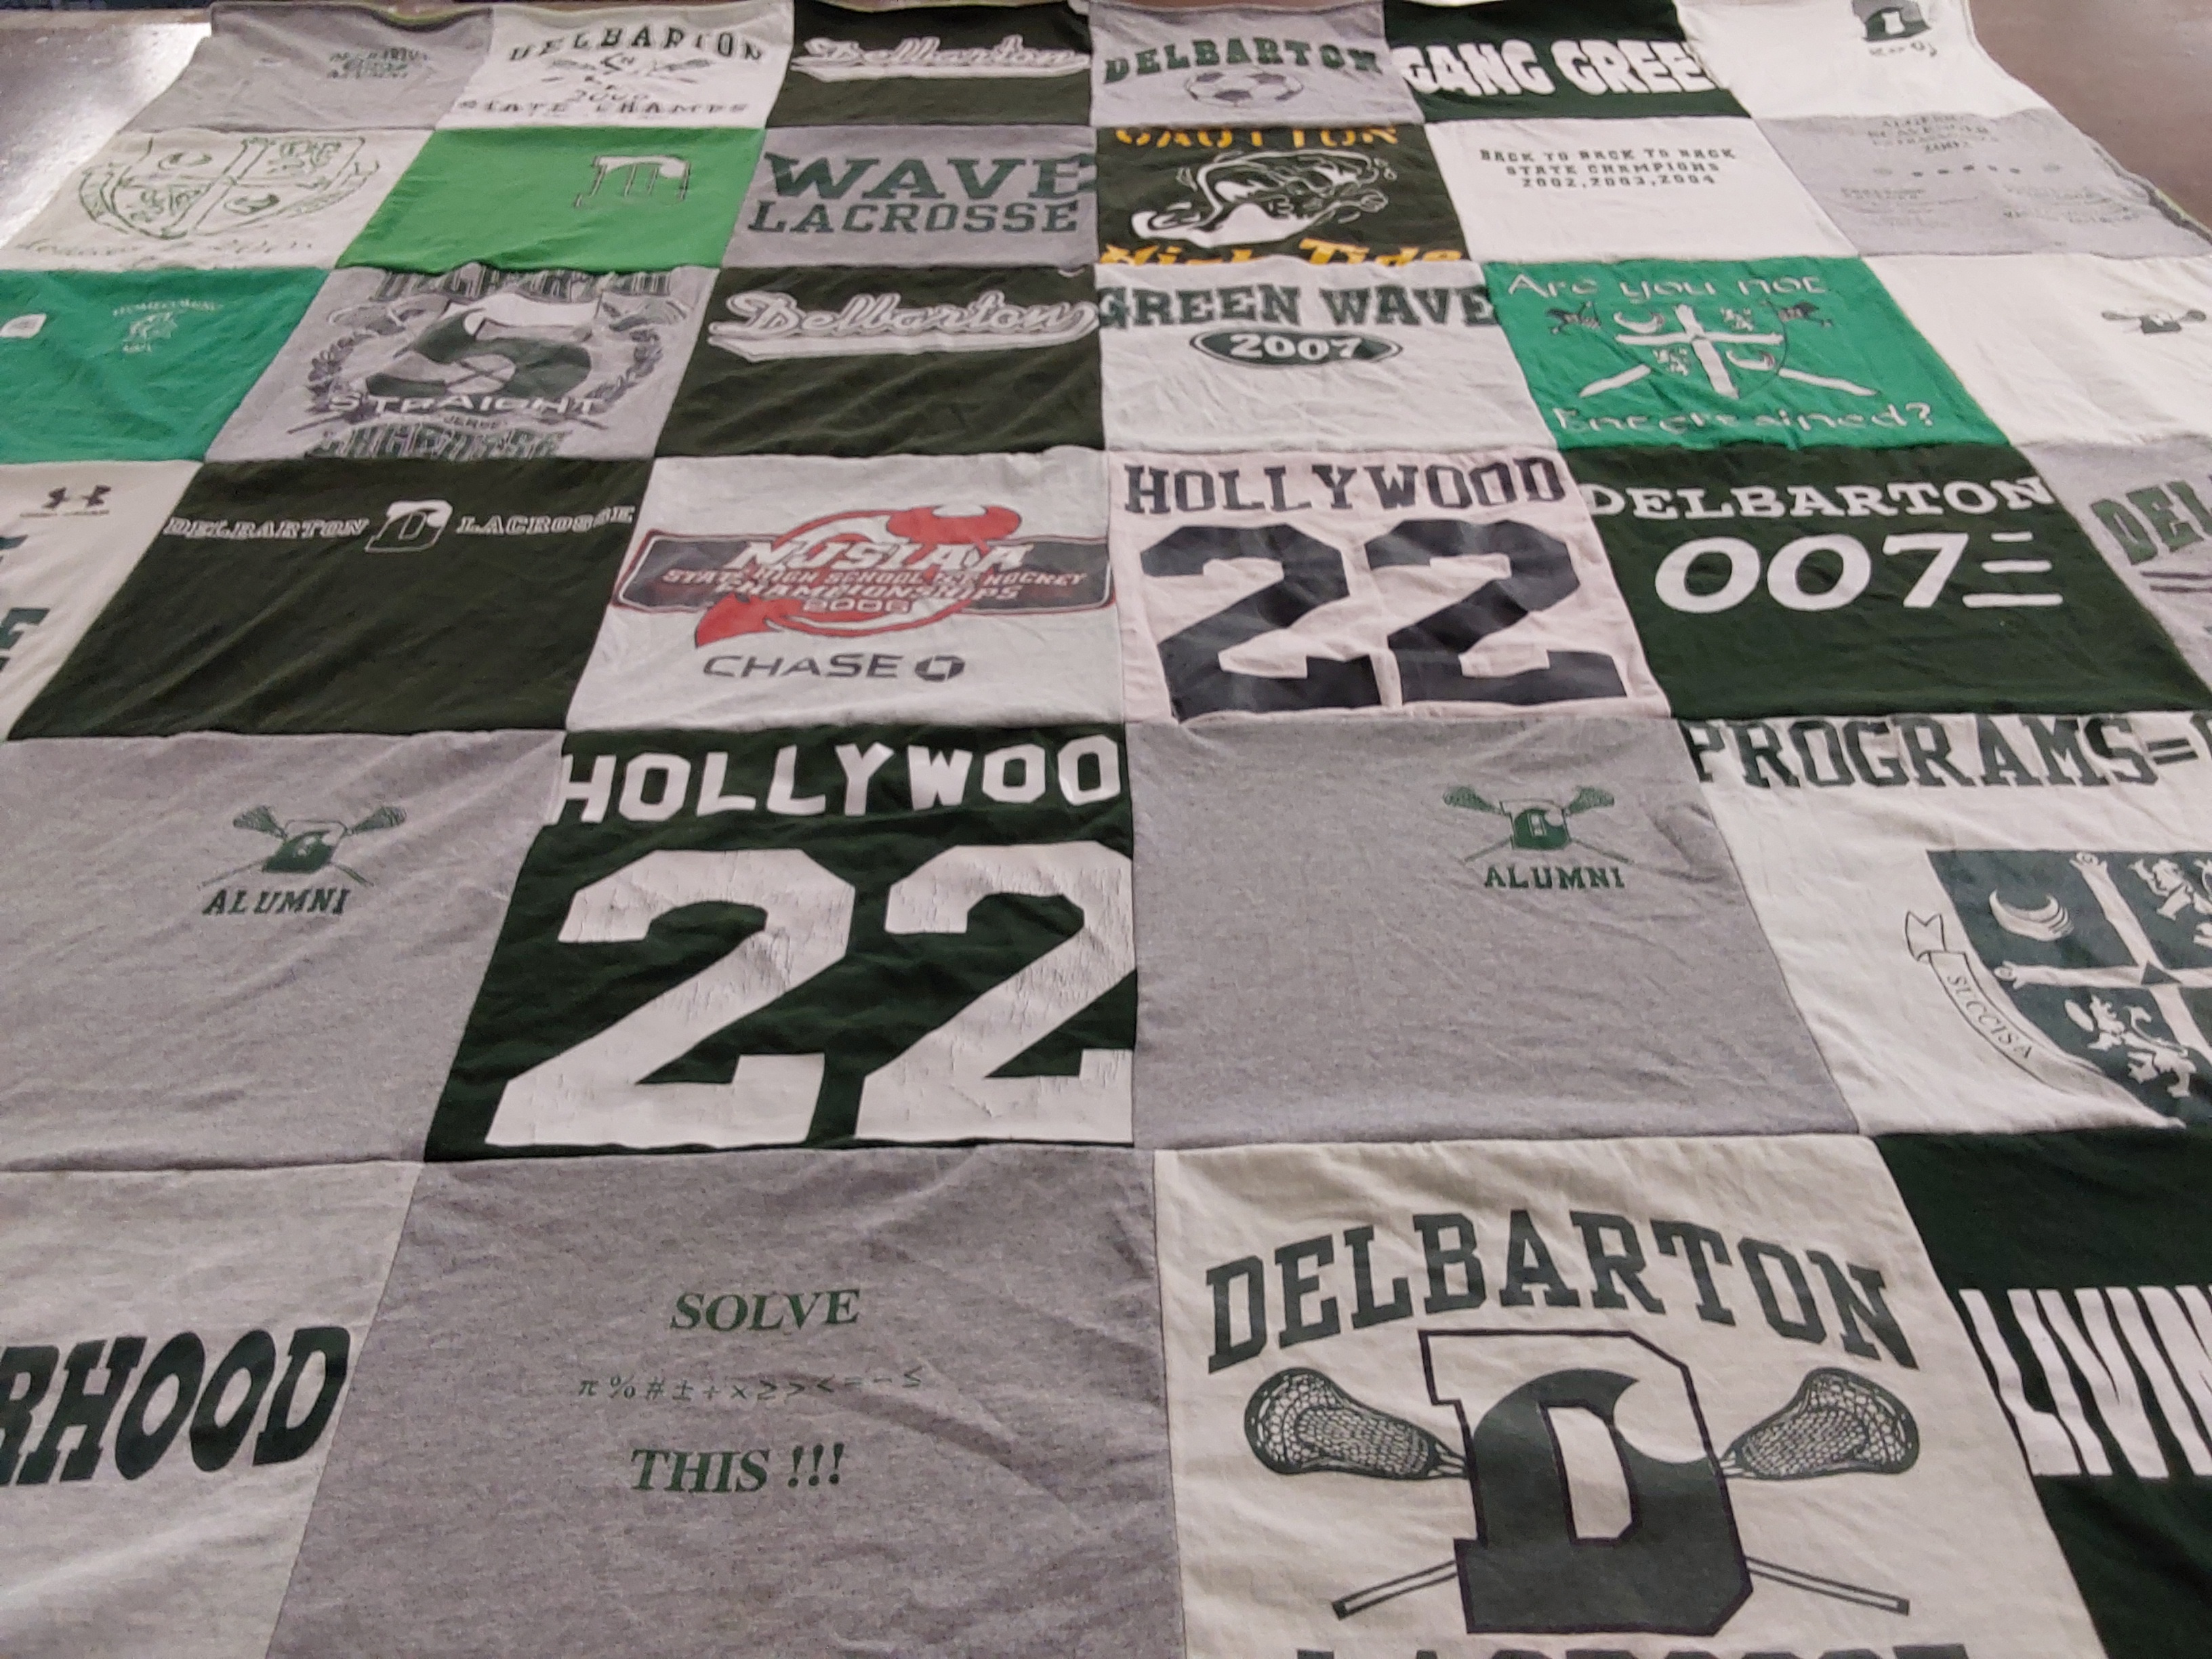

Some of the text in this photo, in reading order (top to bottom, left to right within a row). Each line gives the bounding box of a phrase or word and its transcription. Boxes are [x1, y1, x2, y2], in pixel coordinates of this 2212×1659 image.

[1104, 37, 1383, 84] DELBARTON
[1390, 39, 1728, 96] GANG GREE
[764, 152, 1097, 199] WAVE
[1480, 148, 1736, 162] BACK TO BACK TO BACK
[1506, 161, 1720, 176] STATE CHAMPIONS
[747, 200, 1080, 233] LACROSSE
[1098, 285, 1500, 329] GREEN WAVE
[1508, 274, 1597, 298] Are
[1619, 280, 1716, 305] you
[708, 290, 1099, 347] Delbarton
[1230, 333, 1364, 361] 2007
[1124, 456, 1568, 514] HOLLYWOOD
[1576, 476, 2055, 520] DELBARTON
[163, 516, 370, 539] DELBARTON
[455, 505, 636, 535] LACROSSE
[2089, 474, 2212, 567] DEL
[981, 571, 1088, 586] HOCKEY
[1140, 519, 1629, 722] 22
[703, 652, 903, 678] CHASE
[542, 735, 1122, 826] HOLLYWOO
[1484, 865, 1626, 889] ALUMNI
[202, 888, 352, 916] ALUMNI
[485, 840, 1136, 1148] 22
[1946, 975, 2032, 1059] SUCCISA
[670, 1290, 860, 1331] SOLVE
[1206, 1209, 1919, 1374] DELBARTON
[631, 1447, 771, 1493] THIS
